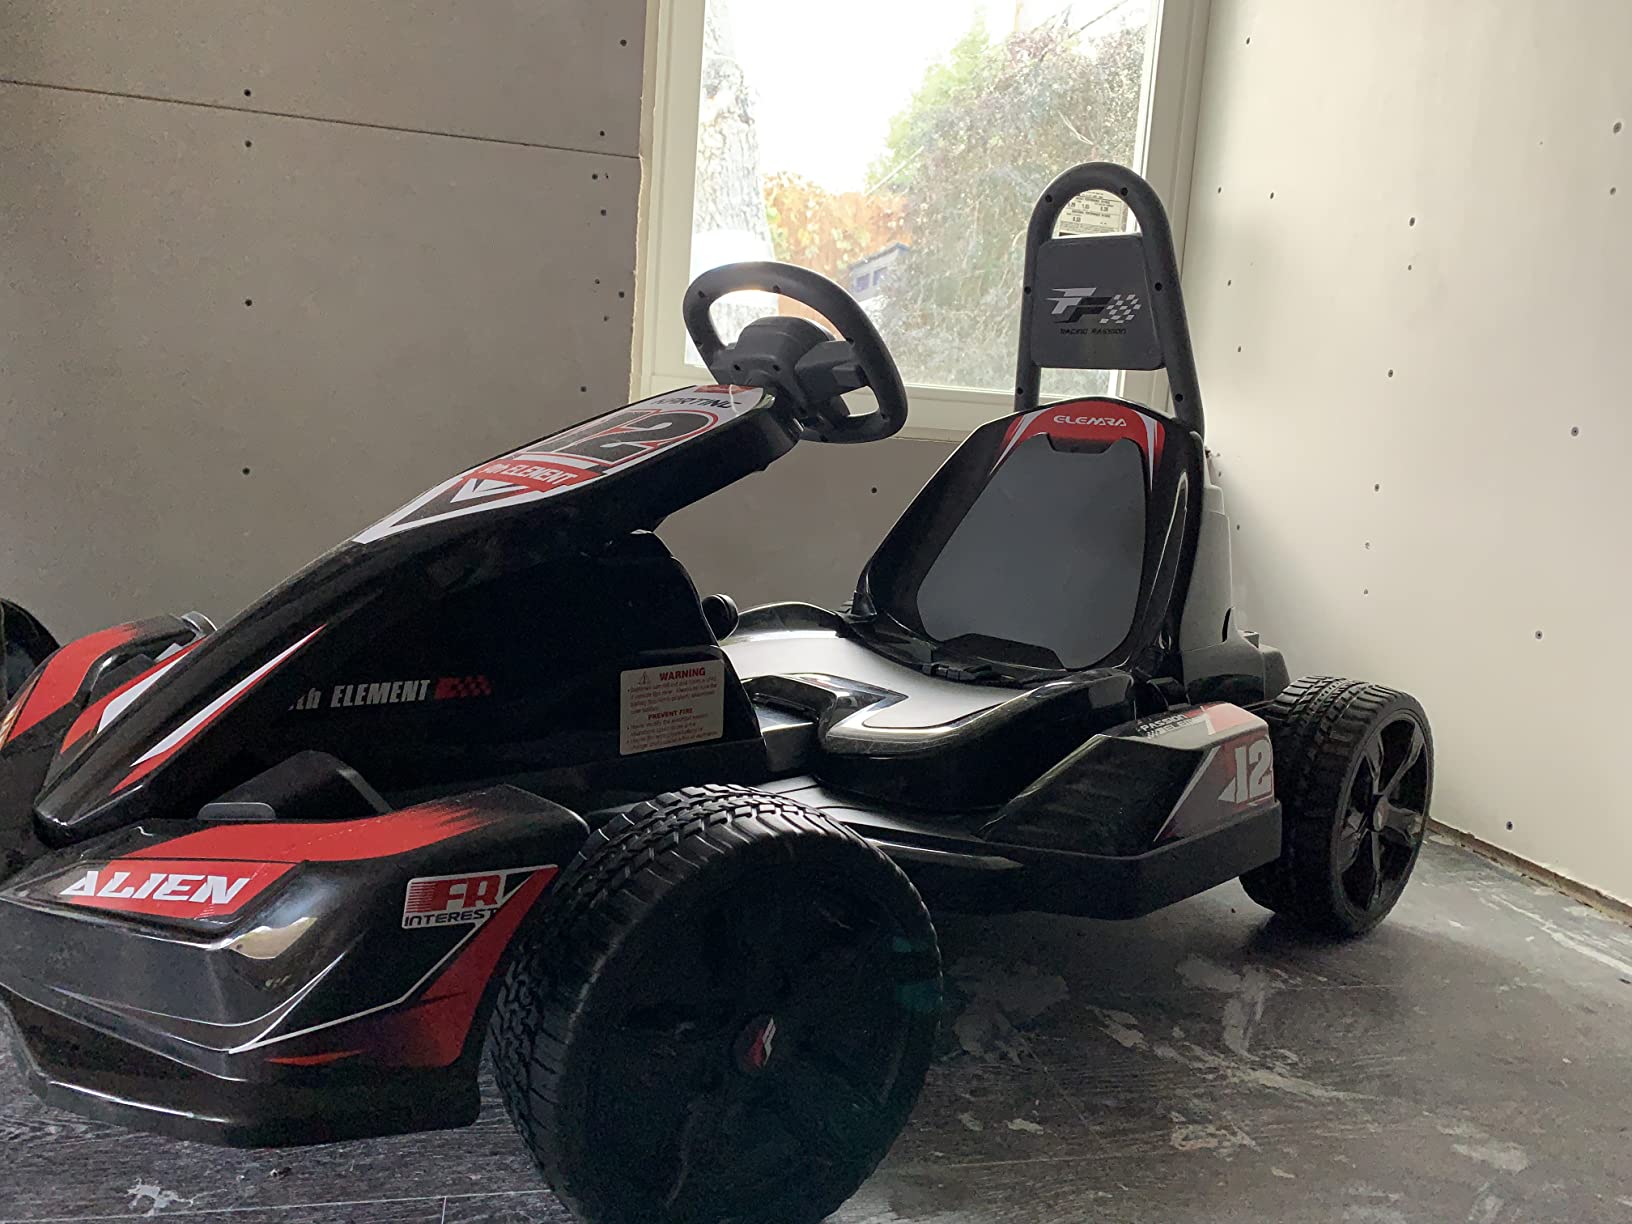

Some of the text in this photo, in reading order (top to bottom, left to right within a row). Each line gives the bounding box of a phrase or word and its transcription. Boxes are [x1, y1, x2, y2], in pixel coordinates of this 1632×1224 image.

[659, 667, 706, 681] WARNING
[330, 679, 431, 708] ELEMENT
[648, 707, 694, 720] PREVENT FIRE
[1234, 739, 1273, 804] 12
[59, 870, 251, 905] ALIEN
